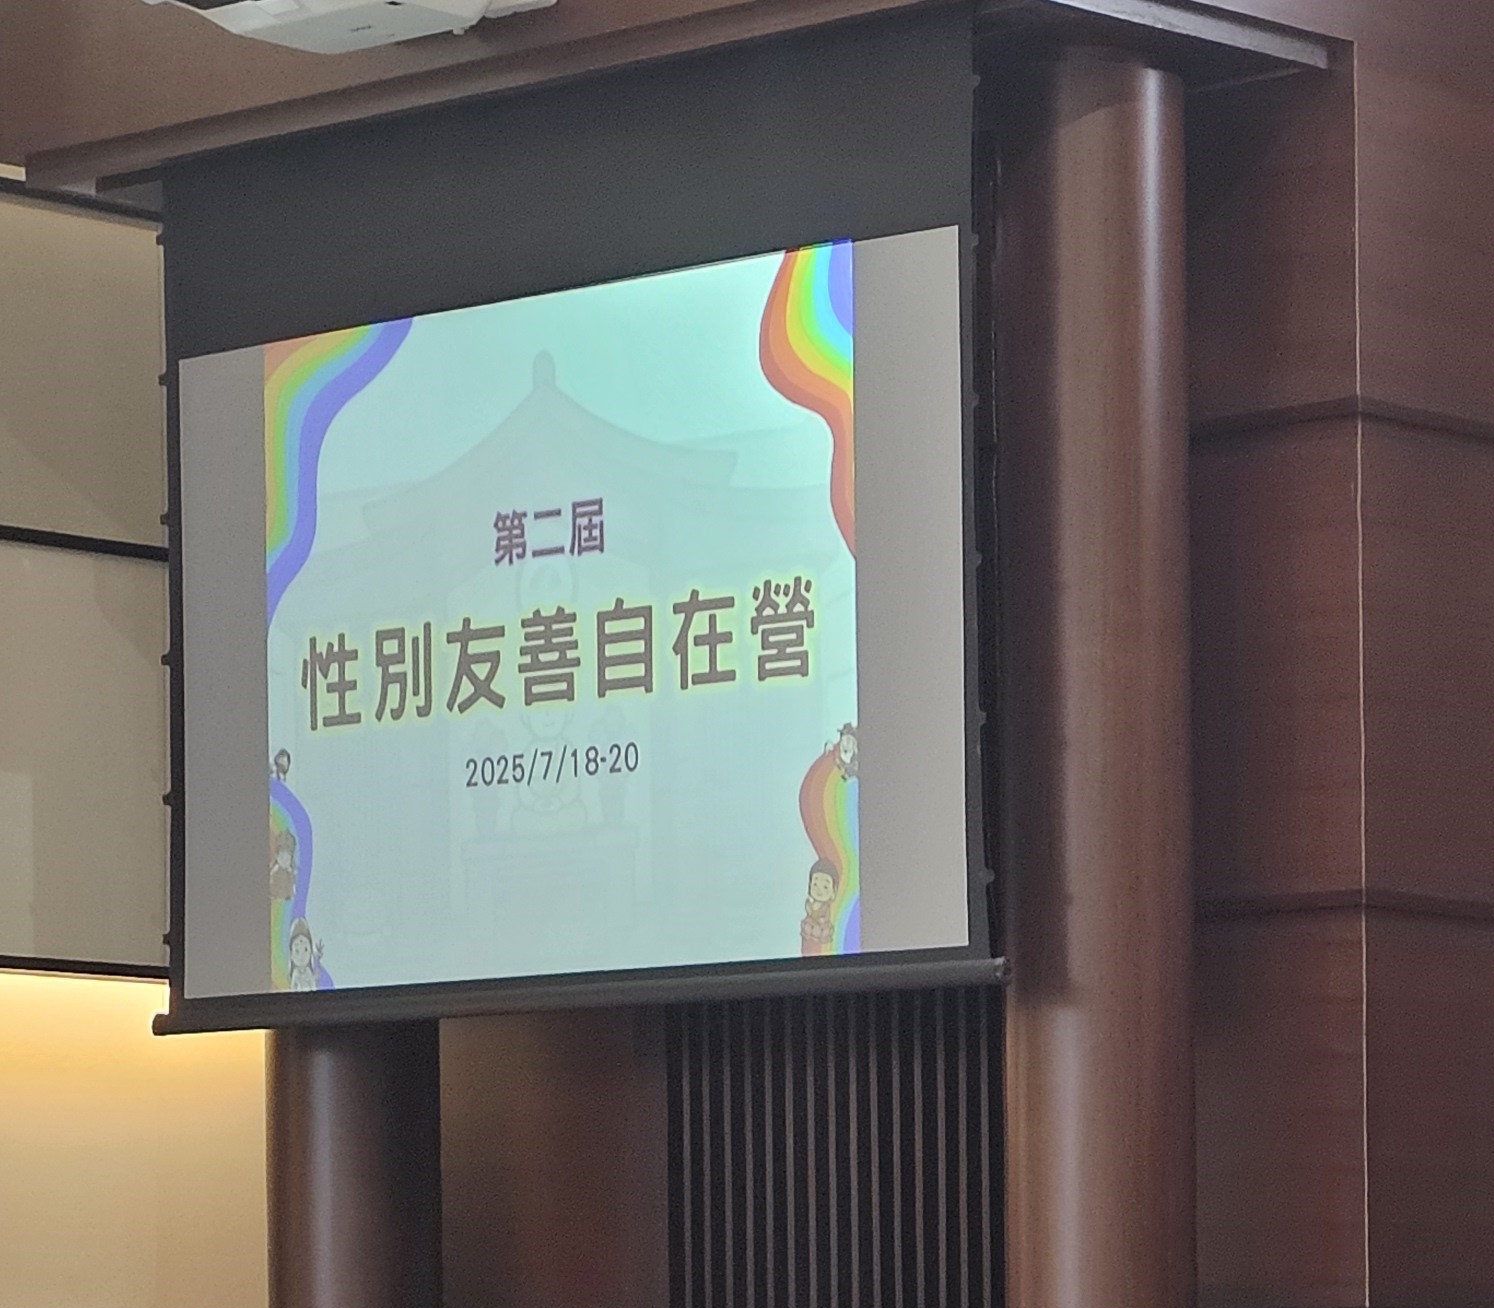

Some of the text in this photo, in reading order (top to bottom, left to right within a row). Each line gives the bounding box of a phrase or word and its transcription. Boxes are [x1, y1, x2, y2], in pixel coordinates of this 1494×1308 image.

[493, 498, 605, 565] 第二屆
[301, 576, 815, 730] 性別友善自在營
[465, 742, 640, 788] 2025/7/18-20
